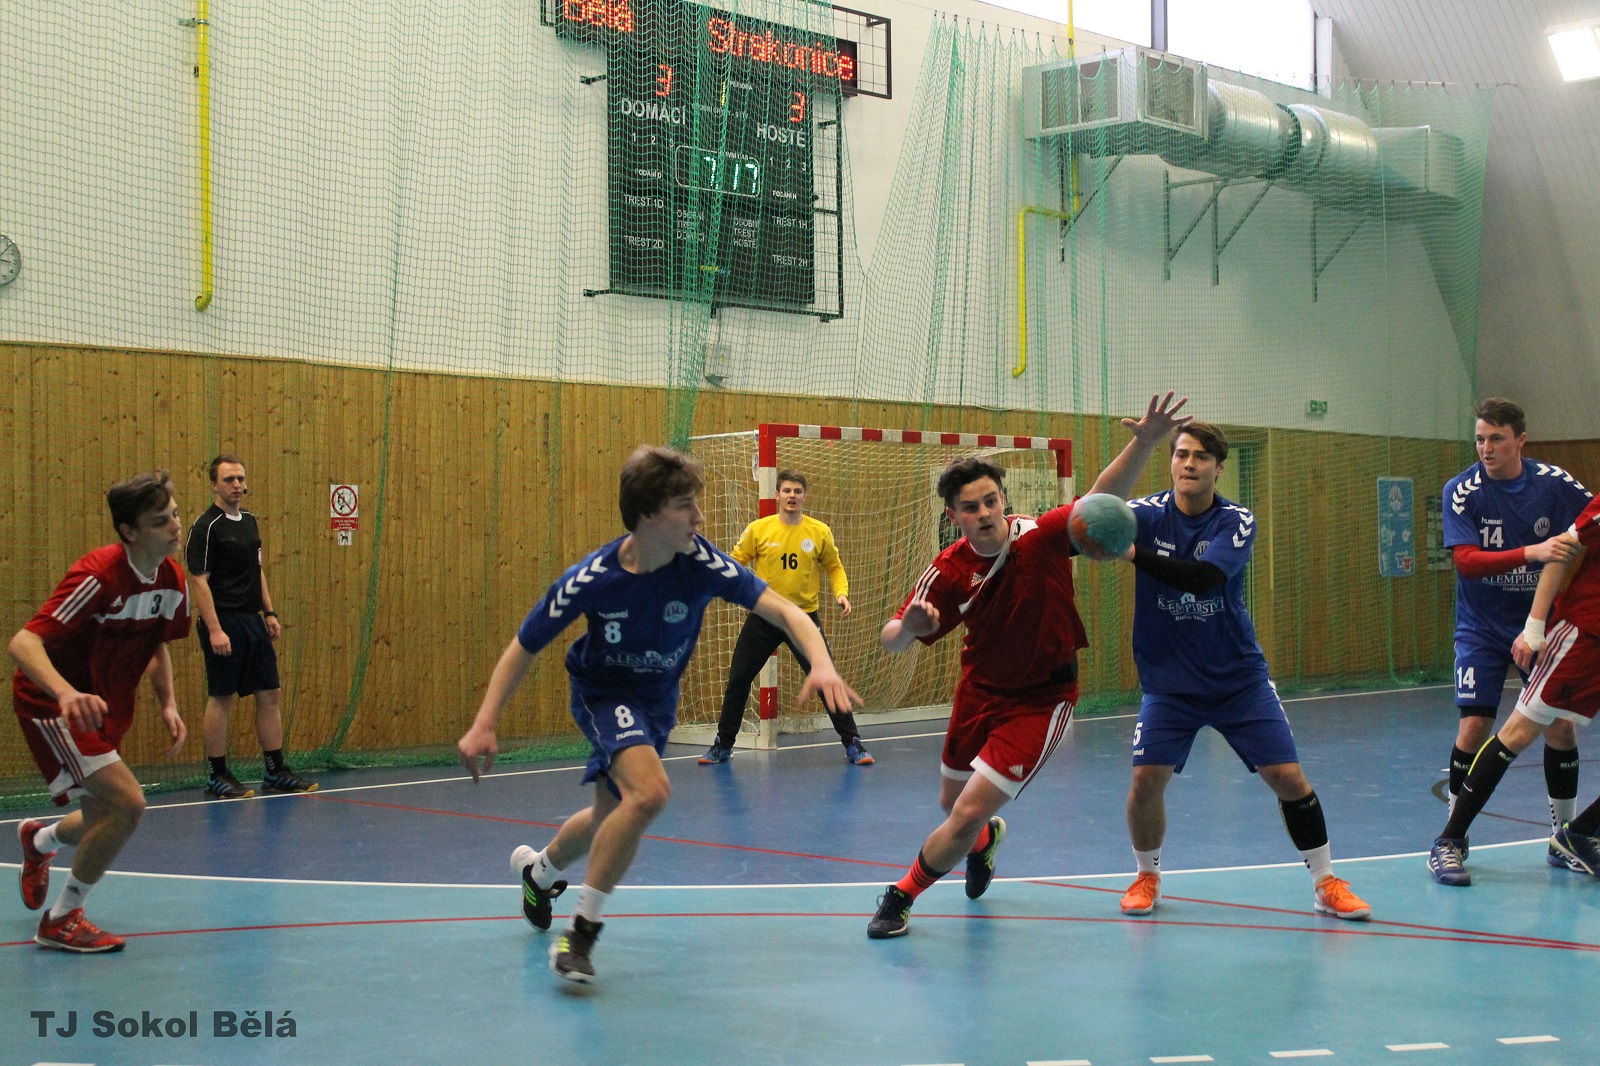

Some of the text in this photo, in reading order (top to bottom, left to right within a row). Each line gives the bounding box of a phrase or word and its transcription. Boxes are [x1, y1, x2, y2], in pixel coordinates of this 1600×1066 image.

[708, 17, 853, 80] Strakonice
[655, 64, 673, 97] 3
[621, 97, 686, 126] DOMÁCÍ
[790, 91, 806, 123] 3
[756, 121, 807, 148] HOSTÉ
[623, 194, 664, 209] TREST 1D
[771, 215, 808, 230] TREST 1H
[623, 234, 664, 249] TREST 2D
[771, 254, 808, 268] TREST 2H
[1479, 526, 1504, 548] 14
[780, 552, 798, 570] 16
[150, 593, 162, 615] 3
[604, 620, 622, 644] 8
[1456, 666, 1476, 689] 14
[614, 704, 635, 729] 8
[1132, 721, 1144, 747] 5
